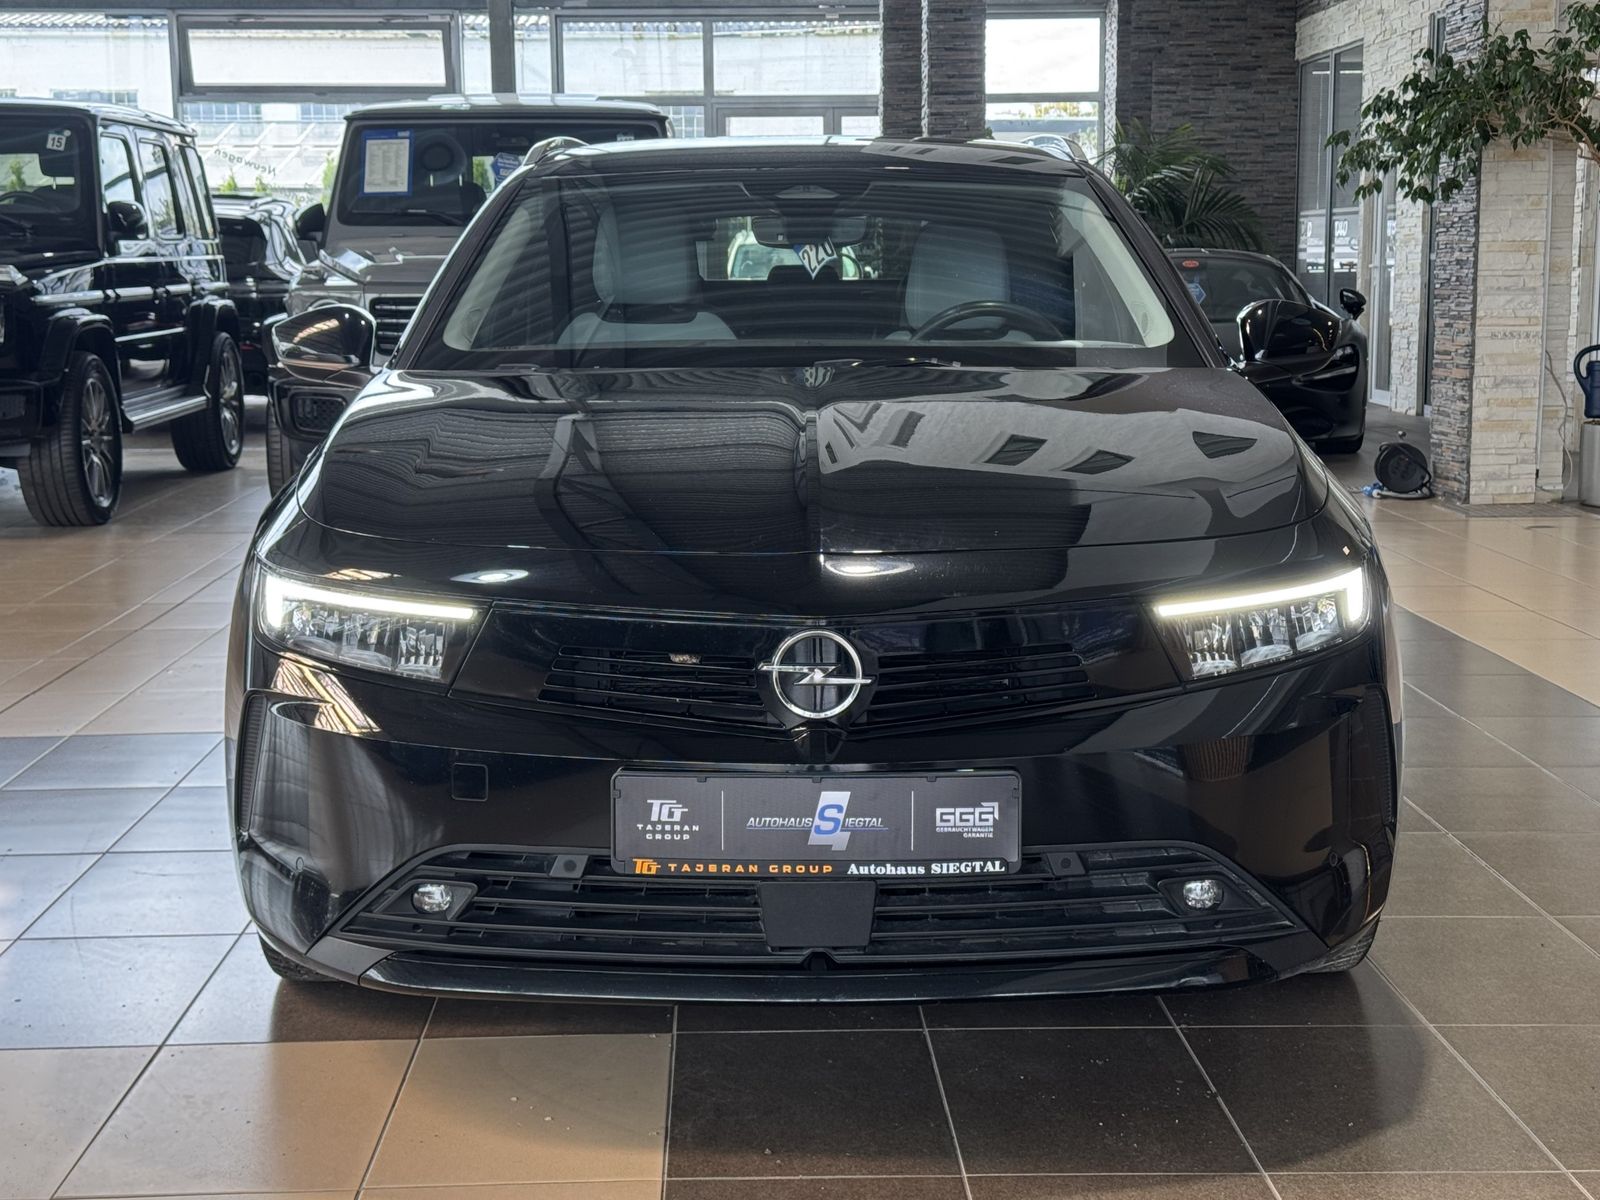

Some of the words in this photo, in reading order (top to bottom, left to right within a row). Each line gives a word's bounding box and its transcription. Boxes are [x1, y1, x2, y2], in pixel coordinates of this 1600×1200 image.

[50, 136, 63, 148] 15
[646, 799, 689, 822] TG
[746, 817, 813, 828] AUTOHAUS
[936, 807, 994, 827] GGG
[636, 824, 700, 832] TAJERAN
[668, 863, 758, 873] TAJERAN
[769, 864, 833, 874] GROUP
[847, 862, 926, 875] Autohaus
[931, 860, 1005, 874] SIEGTAL
